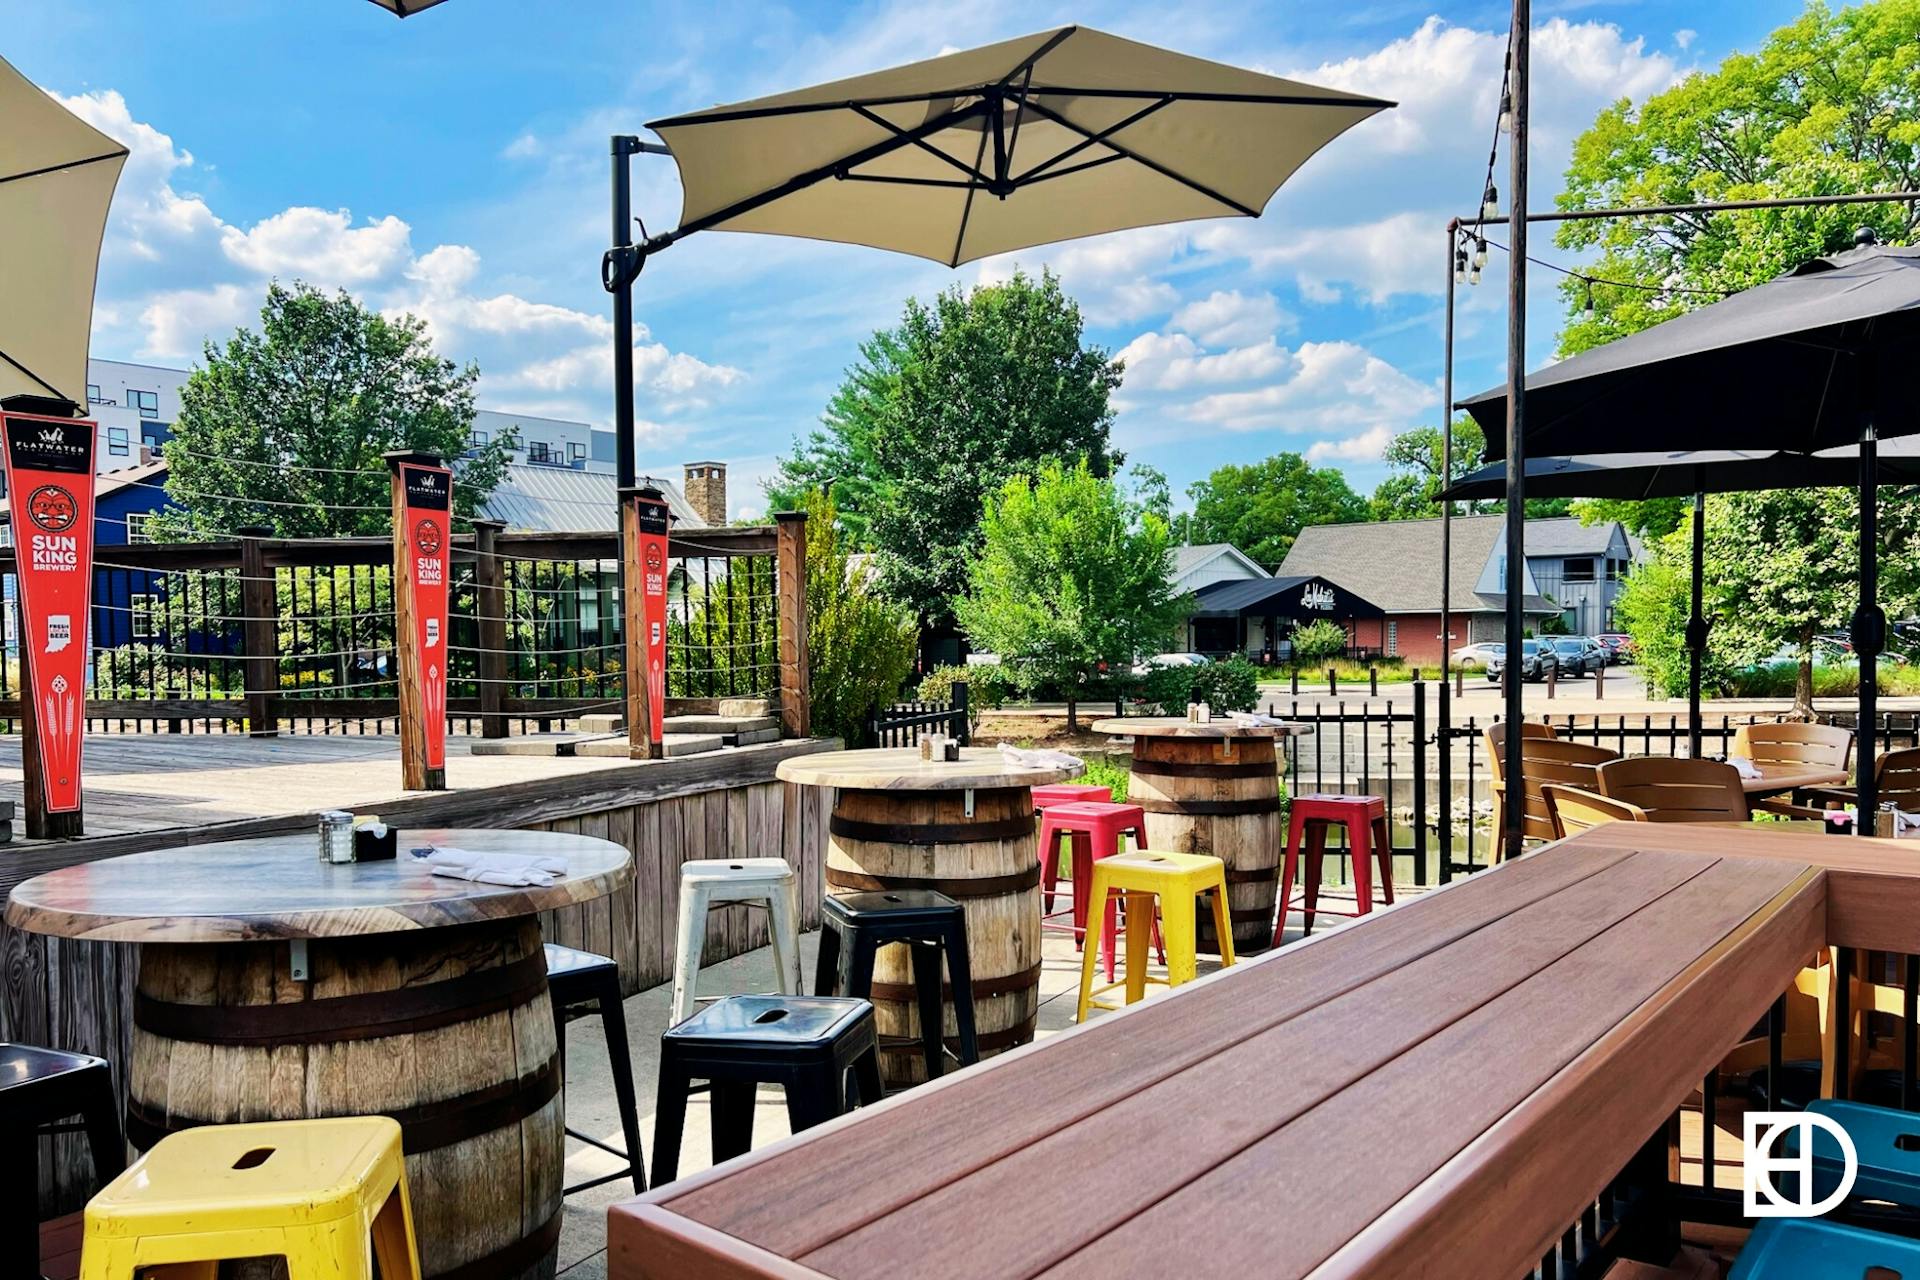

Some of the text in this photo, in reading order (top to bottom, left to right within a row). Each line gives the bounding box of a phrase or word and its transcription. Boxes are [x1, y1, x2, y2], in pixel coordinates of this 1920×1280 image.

[16, 441, 84, 453] FLATWATER
[32, 535, 76, 551] SUN
[32, 550, 77, 564] KING
[33, 564, 76, 572] BREWERY
[418, 558, 441, 570] SUN
[418, 569, 442, 580] KING
[646, 573, 662, 583] SUN
[646, 582, 663, 591] KING
